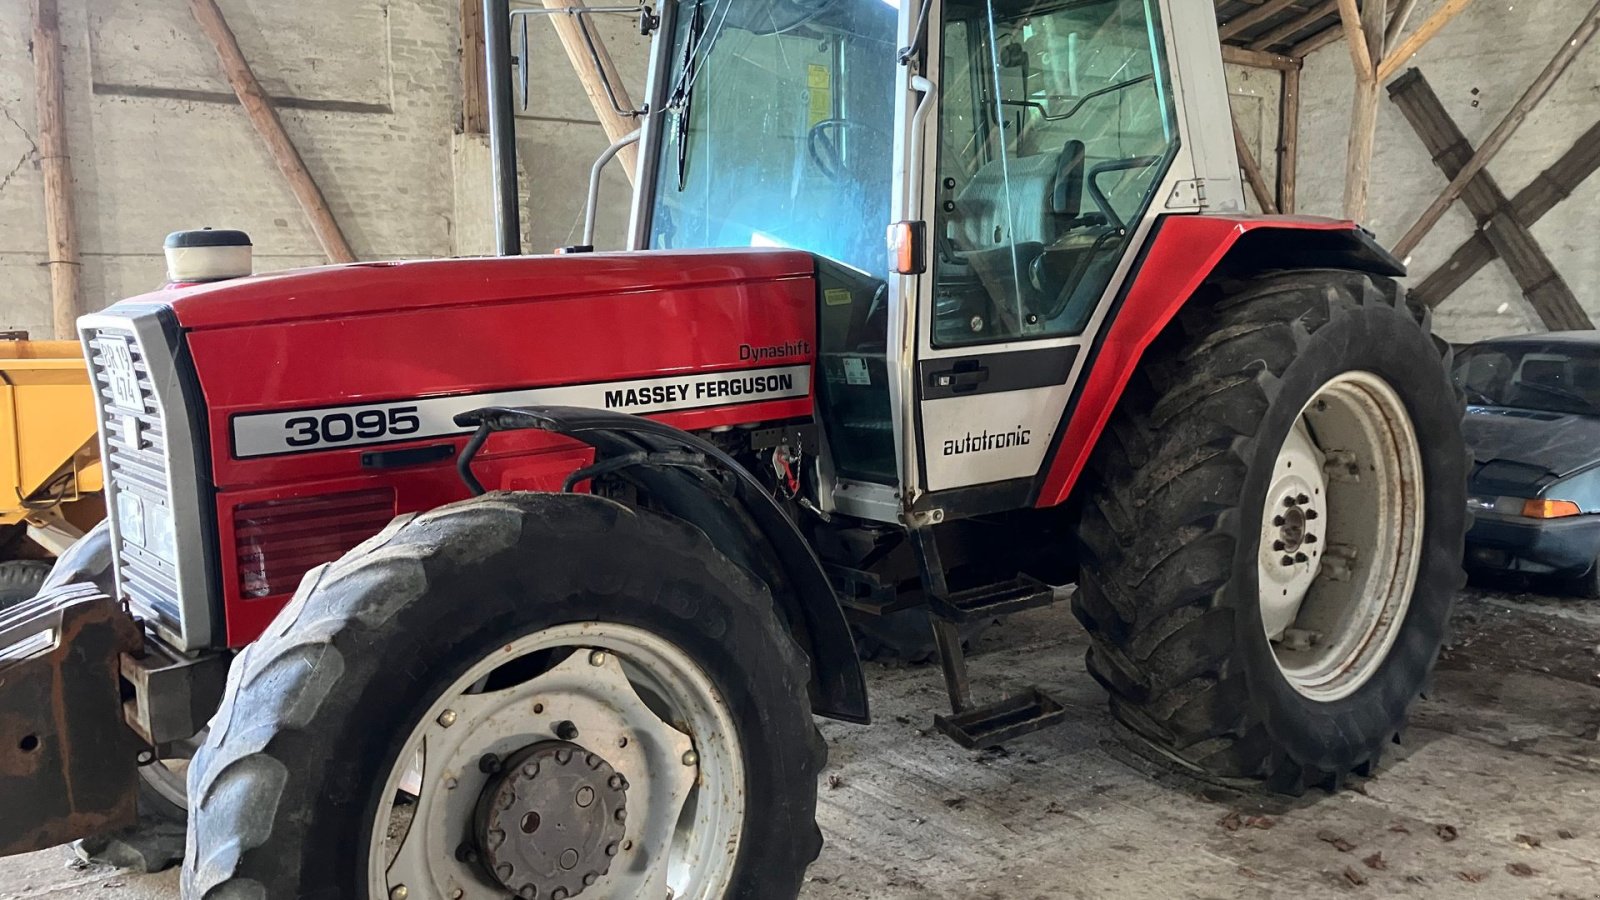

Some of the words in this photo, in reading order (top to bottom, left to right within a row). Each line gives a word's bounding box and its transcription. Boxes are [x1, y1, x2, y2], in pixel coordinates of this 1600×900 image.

[739, 342, 811, 362] Dynashift
[117, 376, 136, 404] 474
[604, 383, 689, 408] MASSEY
[695, 374, 793, 399] FERGUSON
[284, 406, 420, 447] 3095
[943, 424, 1031, 456] autotronic
